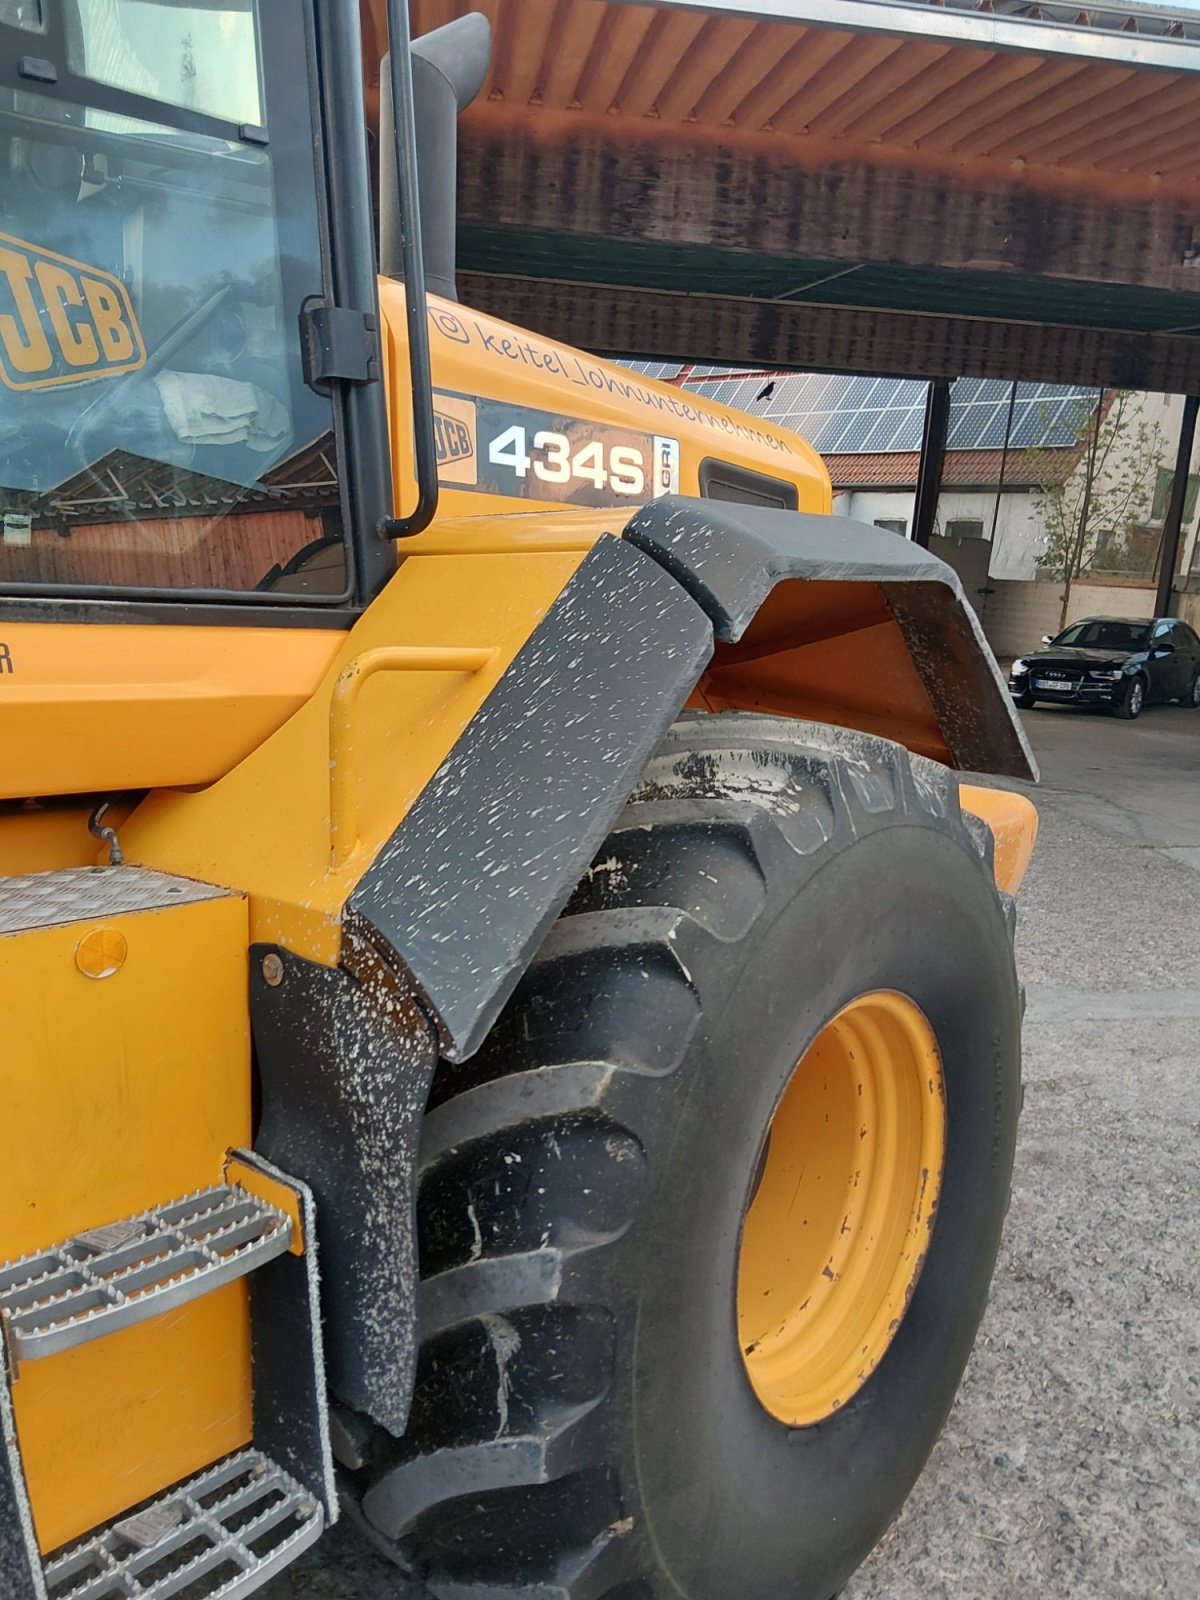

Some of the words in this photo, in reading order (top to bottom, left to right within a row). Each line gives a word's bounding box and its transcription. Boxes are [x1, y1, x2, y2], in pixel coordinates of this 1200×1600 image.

[0, 247, 134, 373] JCB
[474, 322, 793, 454] keitel_lohnunternehmen
[433, 415, 470, 459] JCB
[488, 425, 645, 495] 434S
[661, 443, 671, 495] GRI
